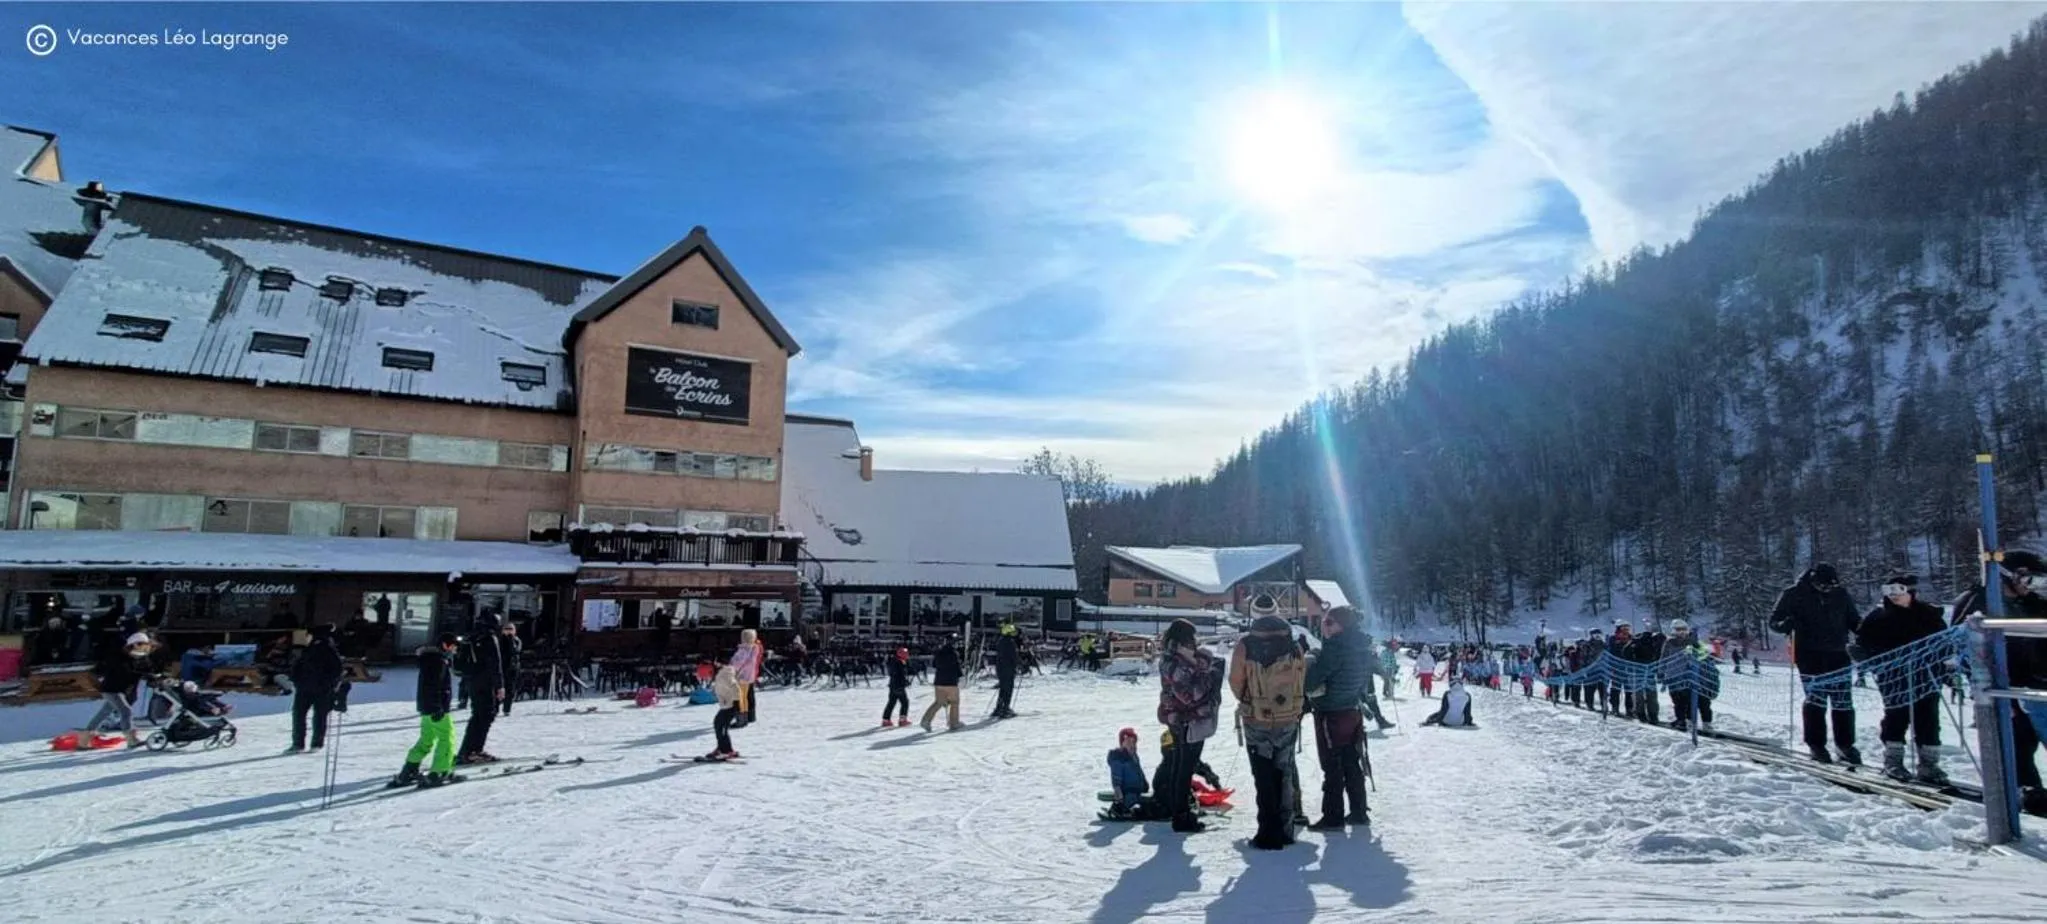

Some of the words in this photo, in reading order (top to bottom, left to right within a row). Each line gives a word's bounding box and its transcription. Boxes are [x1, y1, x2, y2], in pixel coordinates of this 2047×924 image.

[654, 367, 721, 389] Balcon
[163, 579, 192, 594] BAR
[214, 579, 231, 595] 4
[231, 581, 298, 595] saisons
